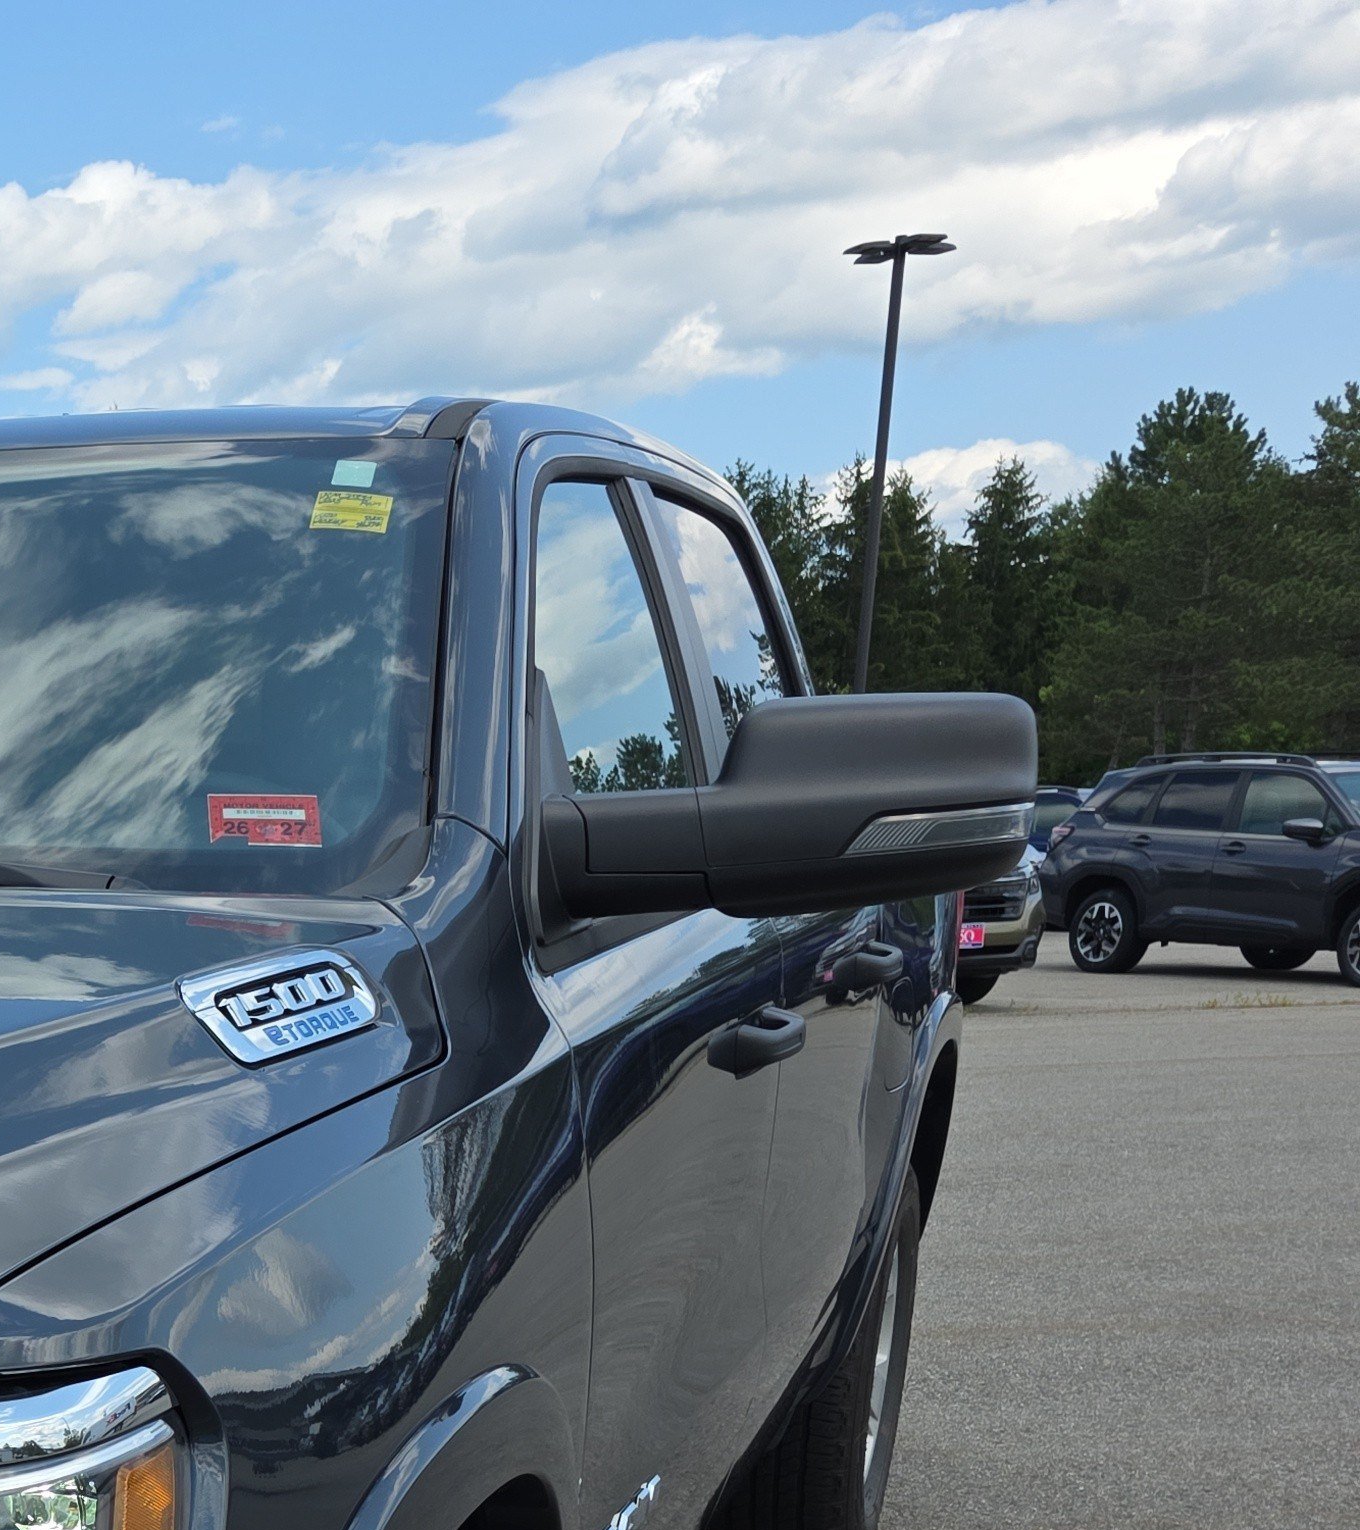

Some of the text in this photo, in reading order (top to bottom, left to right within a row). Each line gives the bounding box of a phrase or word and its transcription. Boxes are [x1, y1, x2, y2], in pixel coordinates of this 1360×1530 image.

[223, 821, 250, 835] 26
[280, 822, 308, 836] 27
[216, 968, 345, 1028] 1500
